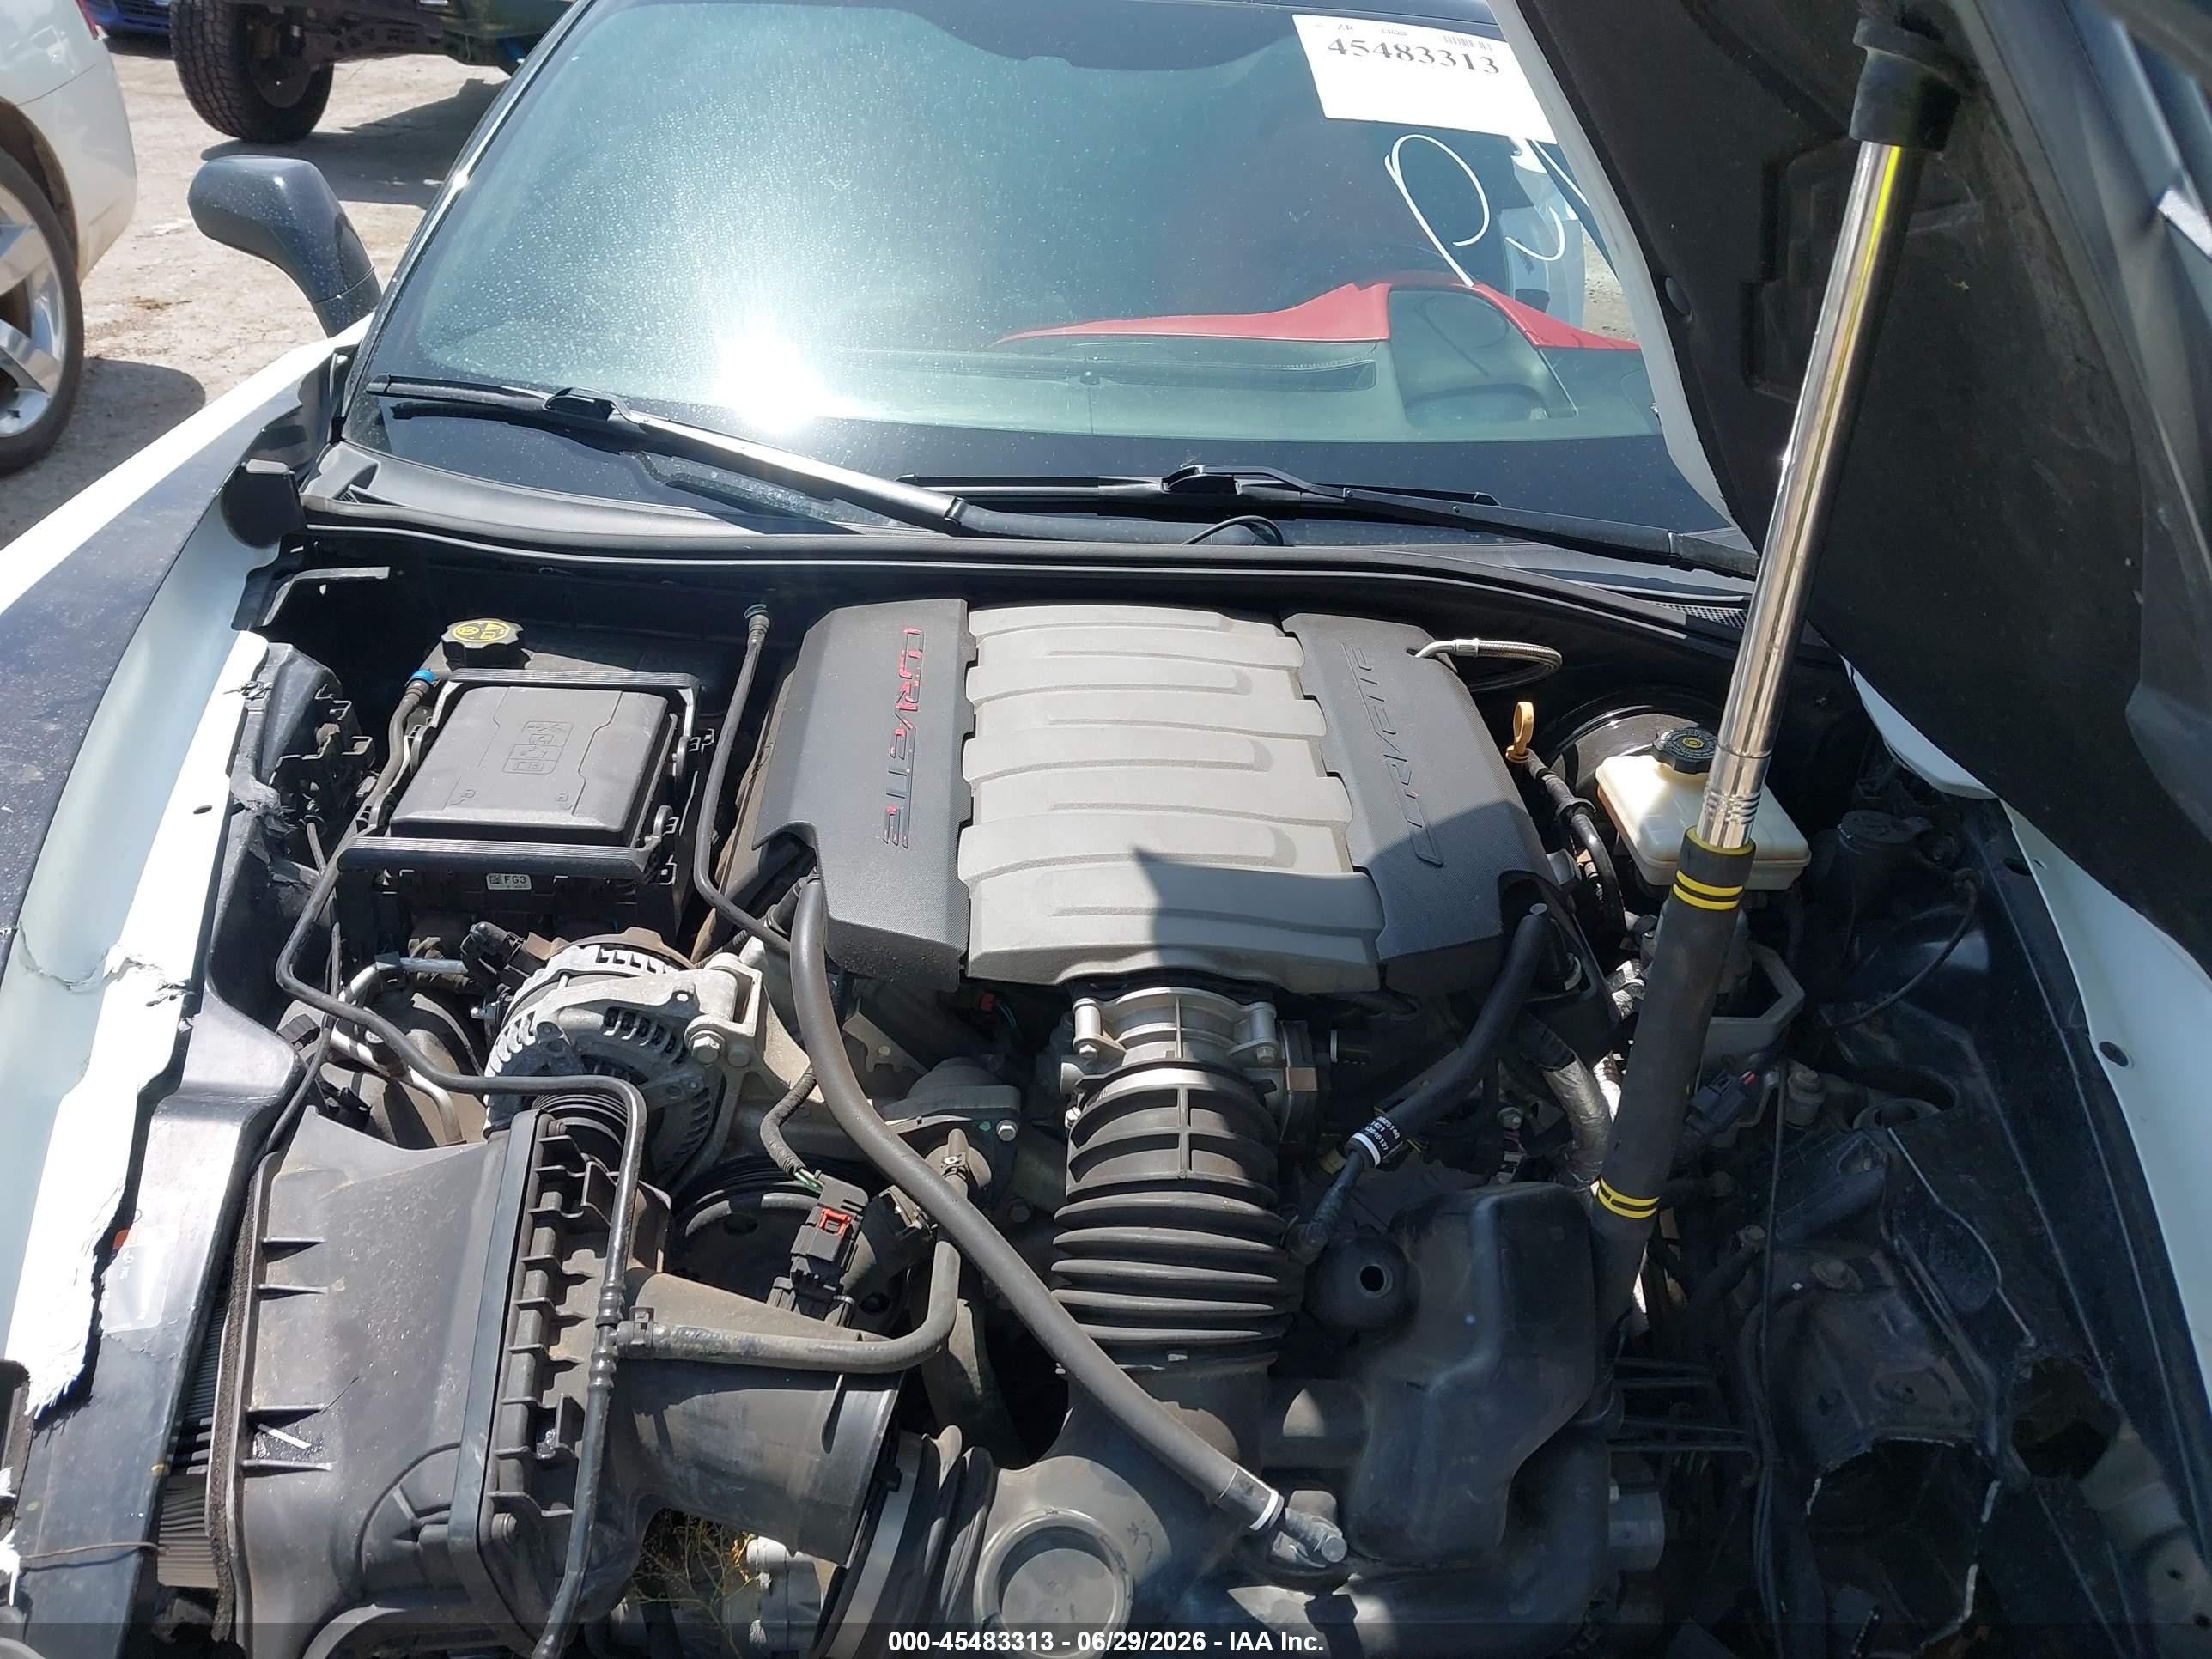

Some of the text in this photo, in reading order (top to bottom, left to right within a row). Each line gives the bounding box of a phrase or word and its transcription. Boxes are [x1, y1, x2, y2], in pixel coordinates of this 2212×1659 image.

[1328, 38, 1499, 75] 45483313
[882, 625, 925, 849] CORVETTE
[1340, 642, 1444, 868] CORVETTE
[504, 875, 527, 884] FG3
